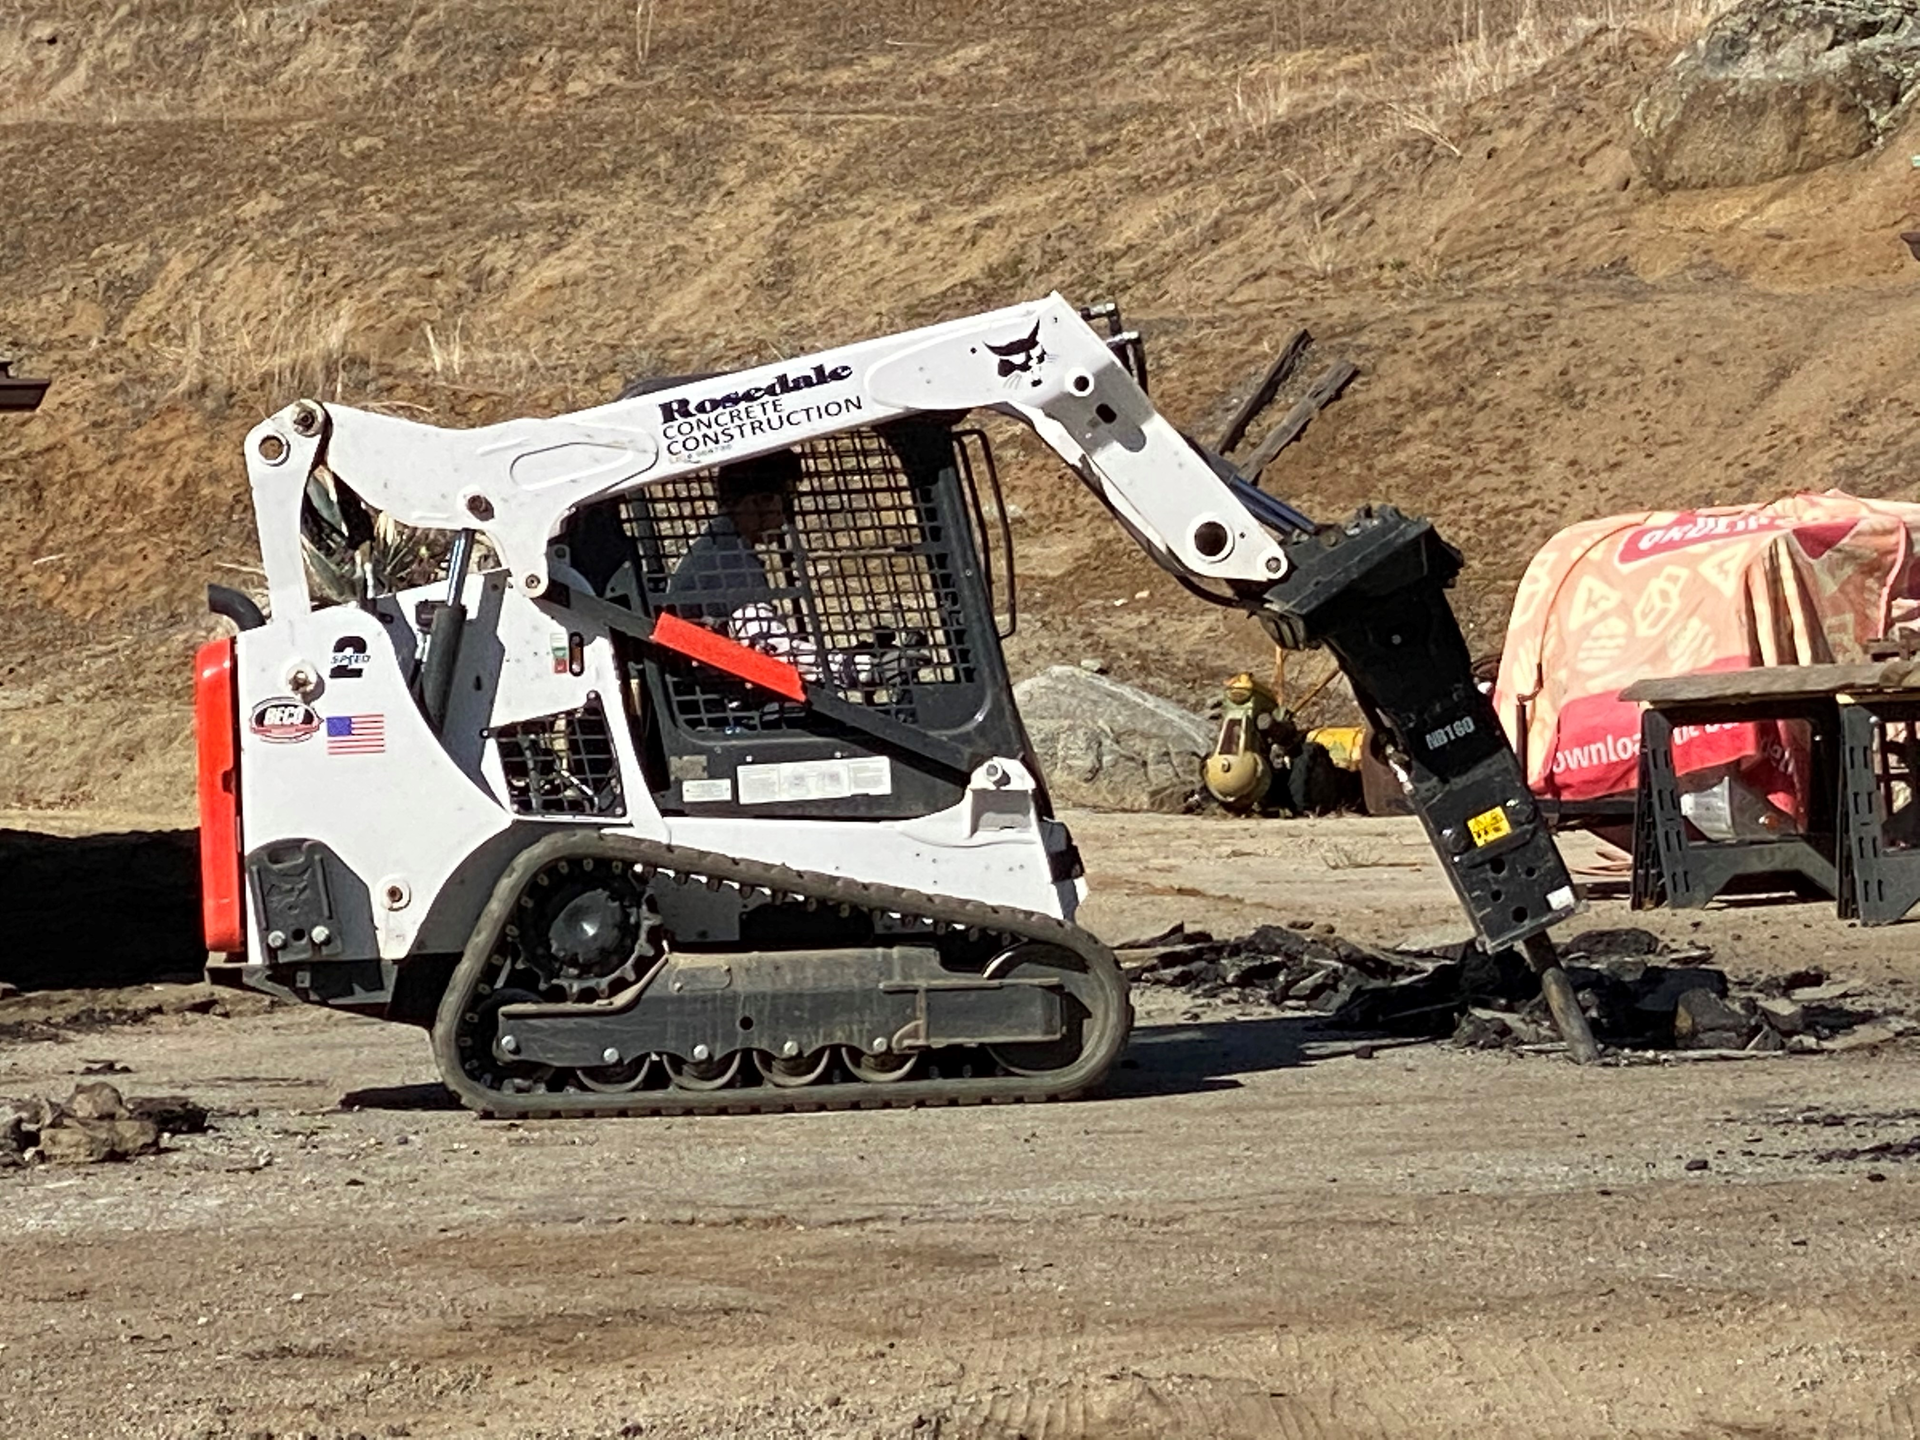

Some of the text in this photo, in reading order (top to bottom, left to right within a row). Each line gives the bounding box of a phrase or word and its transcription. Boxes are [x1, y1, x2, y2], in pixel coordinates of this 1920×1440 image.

[658, 364, 853, 424] Rosedale
[663, 398, 786, 439] CONCRETE
[667, 395, 863, 456] CONSTRUCTION
[329, 635, 367, 679] 2
